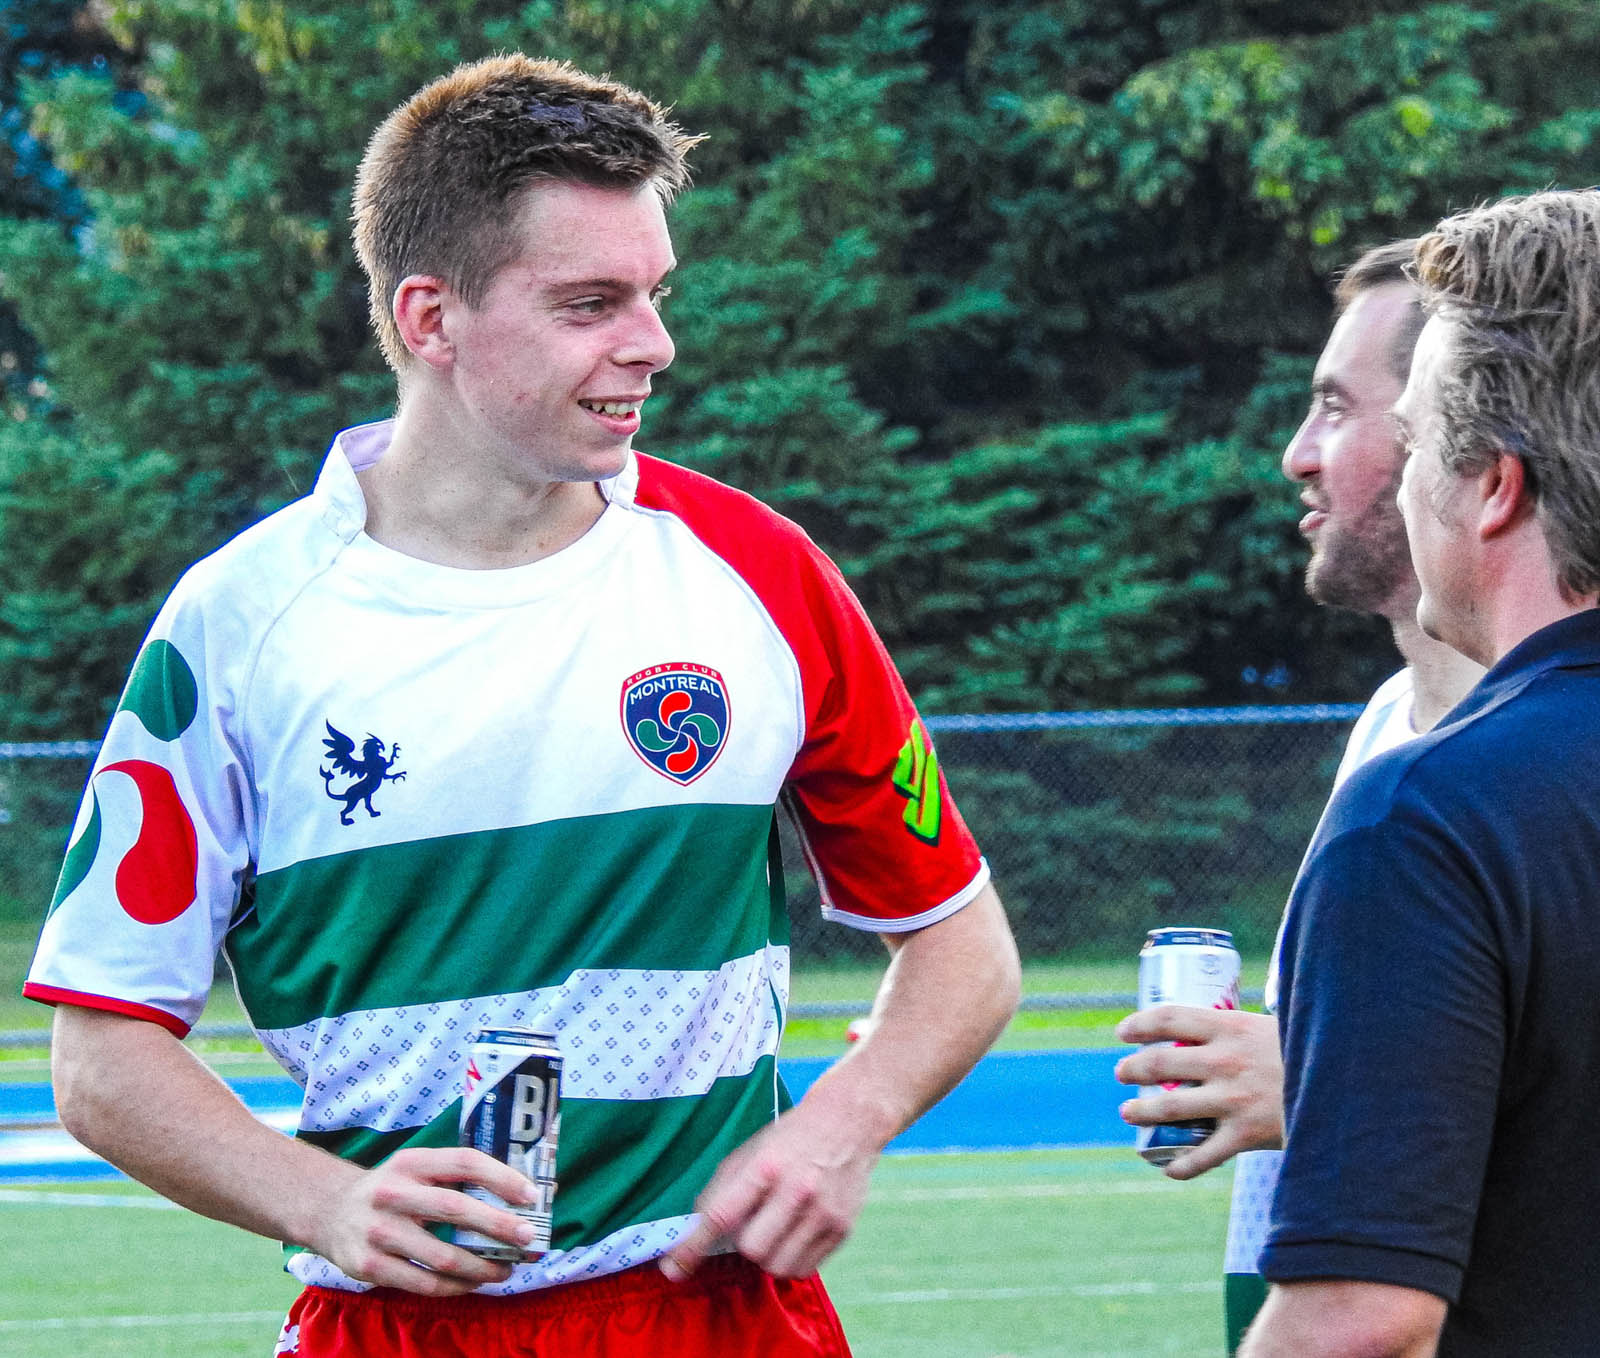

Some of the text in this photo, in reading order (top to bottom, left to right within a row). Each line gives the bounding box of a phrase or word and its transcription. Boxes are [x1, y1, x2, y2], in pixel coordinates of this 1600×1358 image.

[626, 663, 718, 686] RUGBY CLUB
[629, 676, 720, 705] MONTREAL
